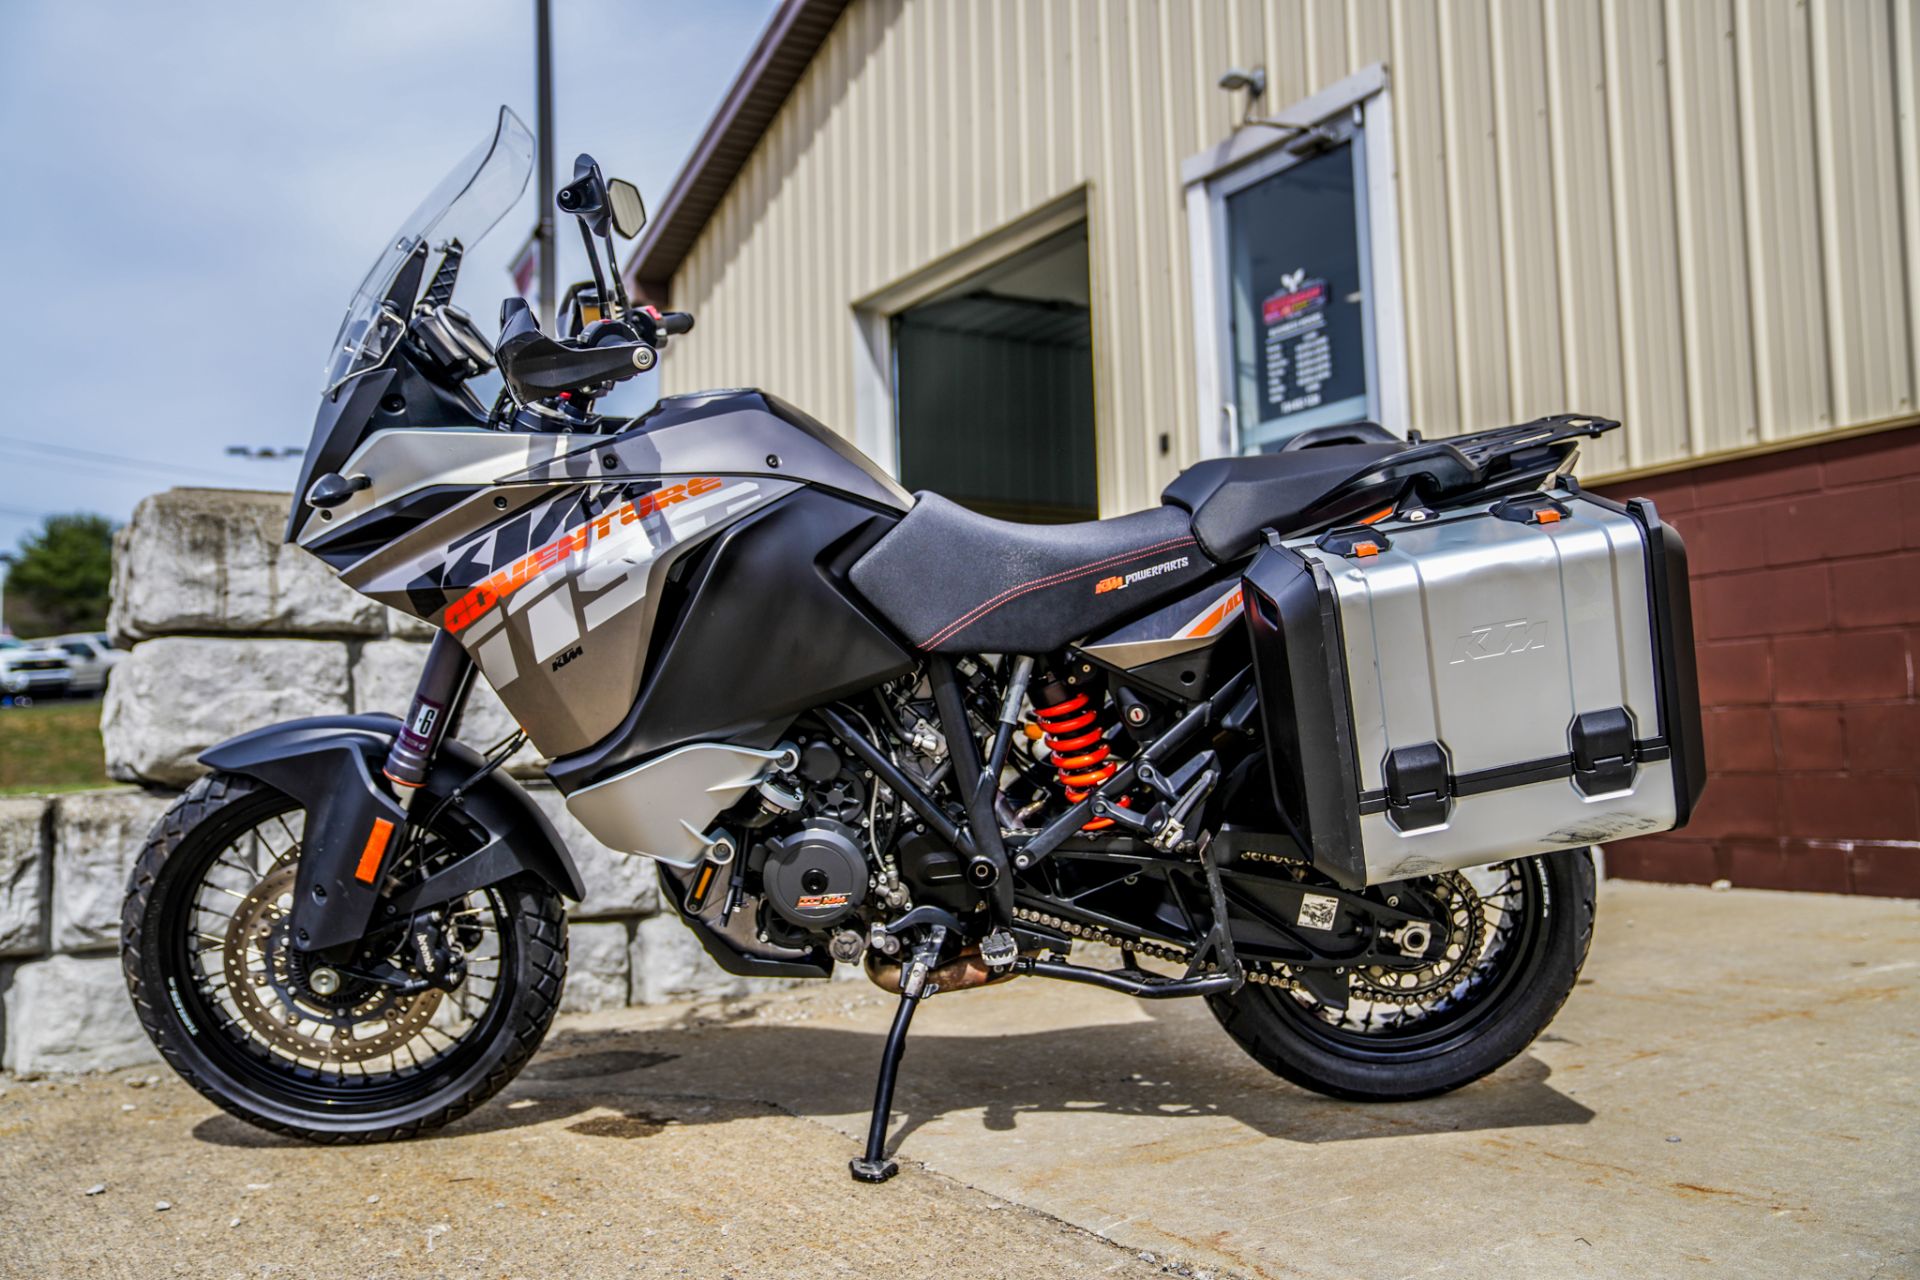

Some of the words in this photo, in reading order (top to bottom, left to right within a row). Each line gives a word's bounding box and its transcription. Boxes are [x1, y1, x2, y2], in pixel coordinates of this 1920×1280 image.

[443, 477, 722, 634] ADVENTURE
[1125, 556, 1190, 586] POWERPARTS
[551, 645, 584, 672] KTM
[1449, 617, 1549, 665] KTM
[416, 933, 435, 973] brembo
